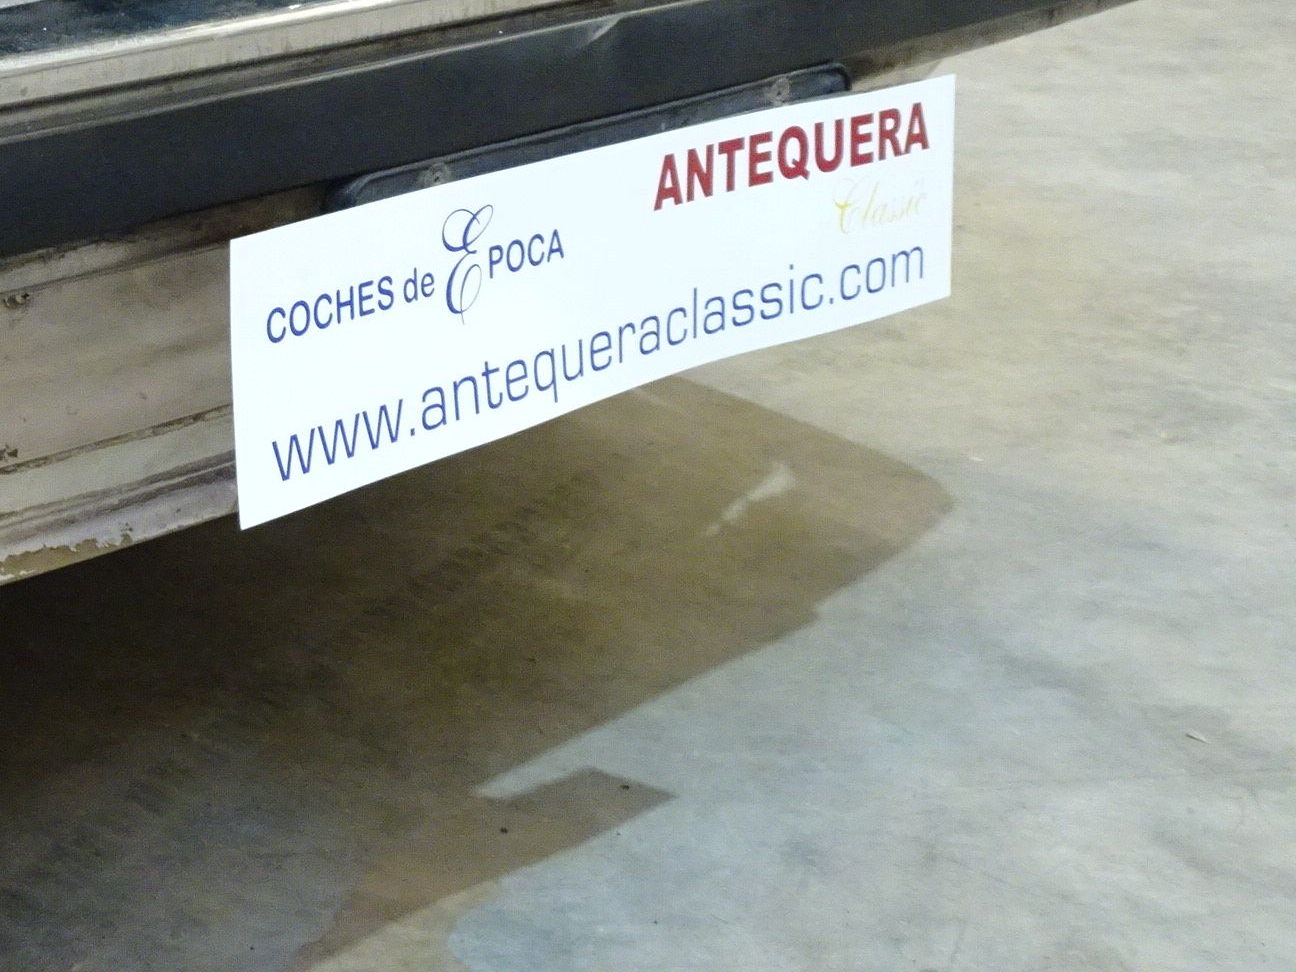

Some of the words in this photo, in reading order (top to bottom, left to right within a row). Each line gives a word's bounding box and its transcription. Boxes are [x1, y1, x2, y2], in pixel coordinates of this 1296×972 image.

[653, 102, 930, 211] ANTEQUERA
[266, 275, 395, 343] COCHES
[403, 267, 435, 304] de
[270, 245, 925, 481] www.antequeraclassic.com
